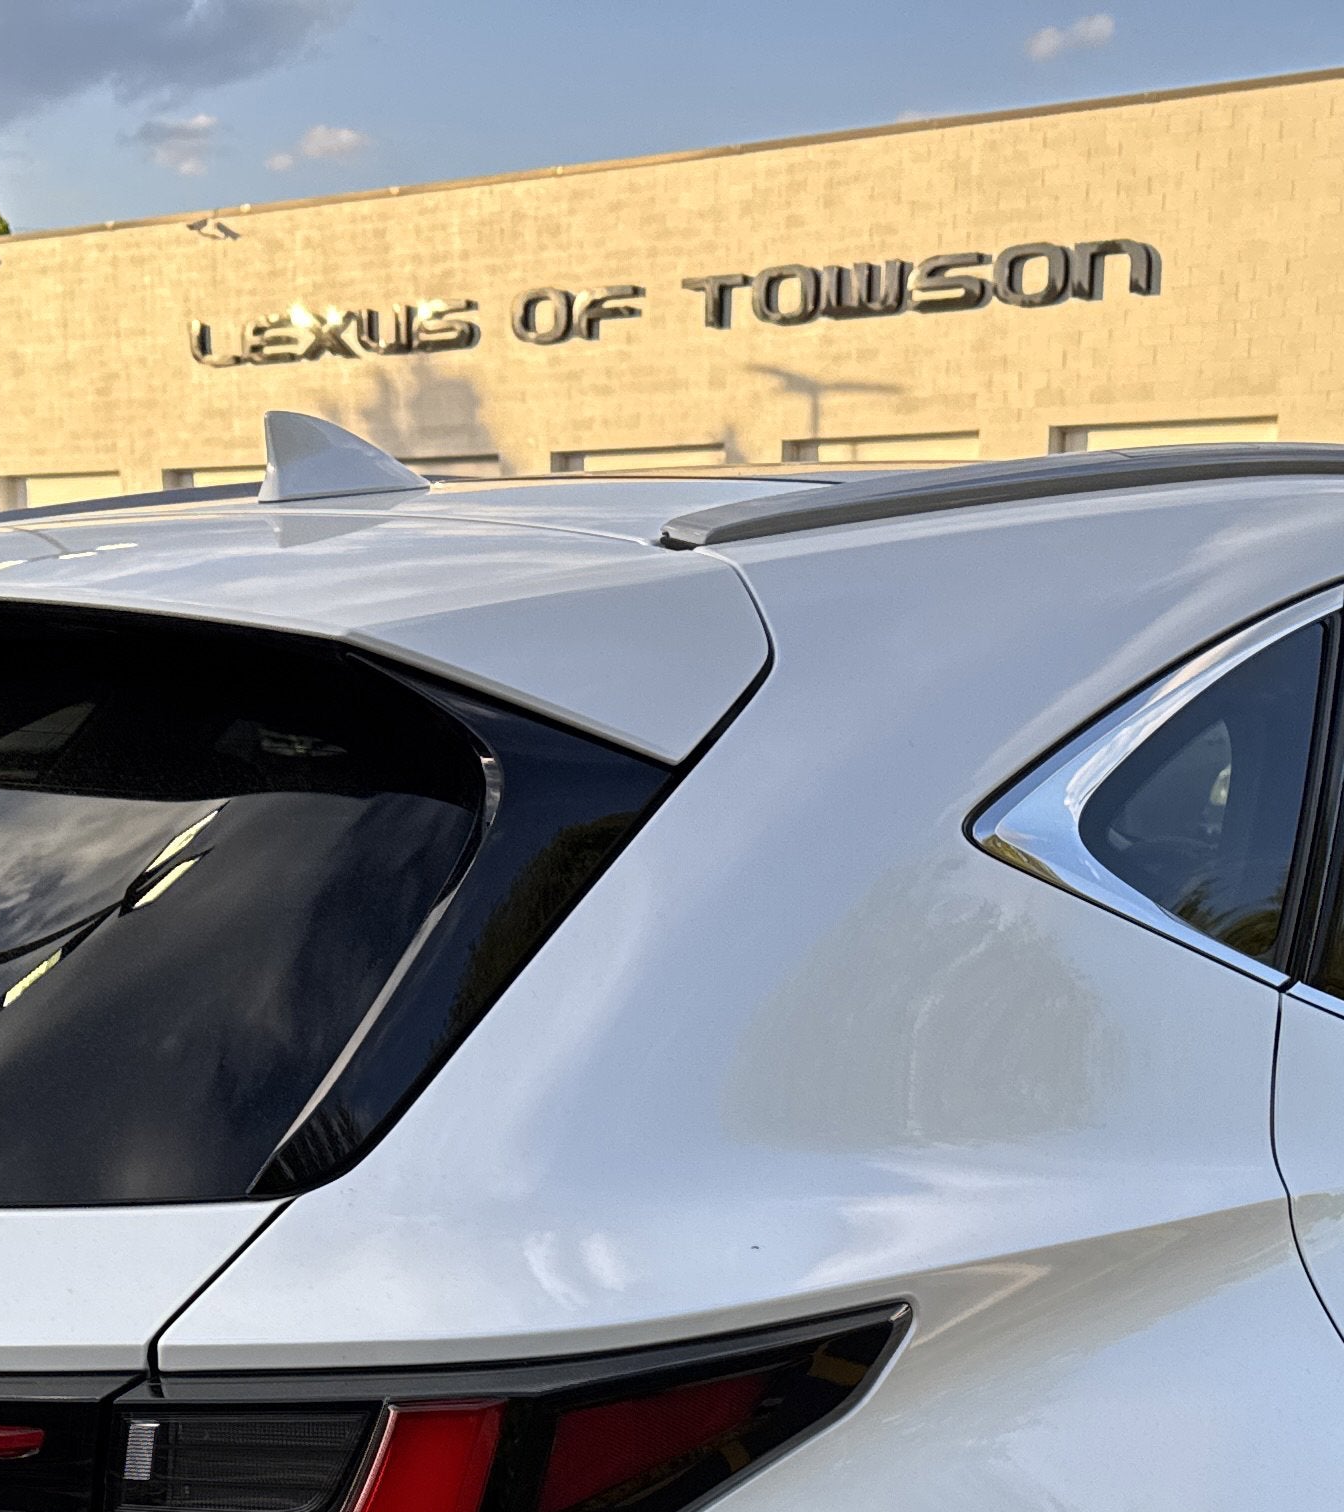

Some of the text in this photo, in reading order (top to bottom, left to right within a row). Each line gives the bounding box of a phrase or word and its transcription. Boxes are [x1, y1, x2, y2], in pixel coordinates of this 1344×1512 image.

[189, 239, 1162, 367] LEXUS OF TOWSON
